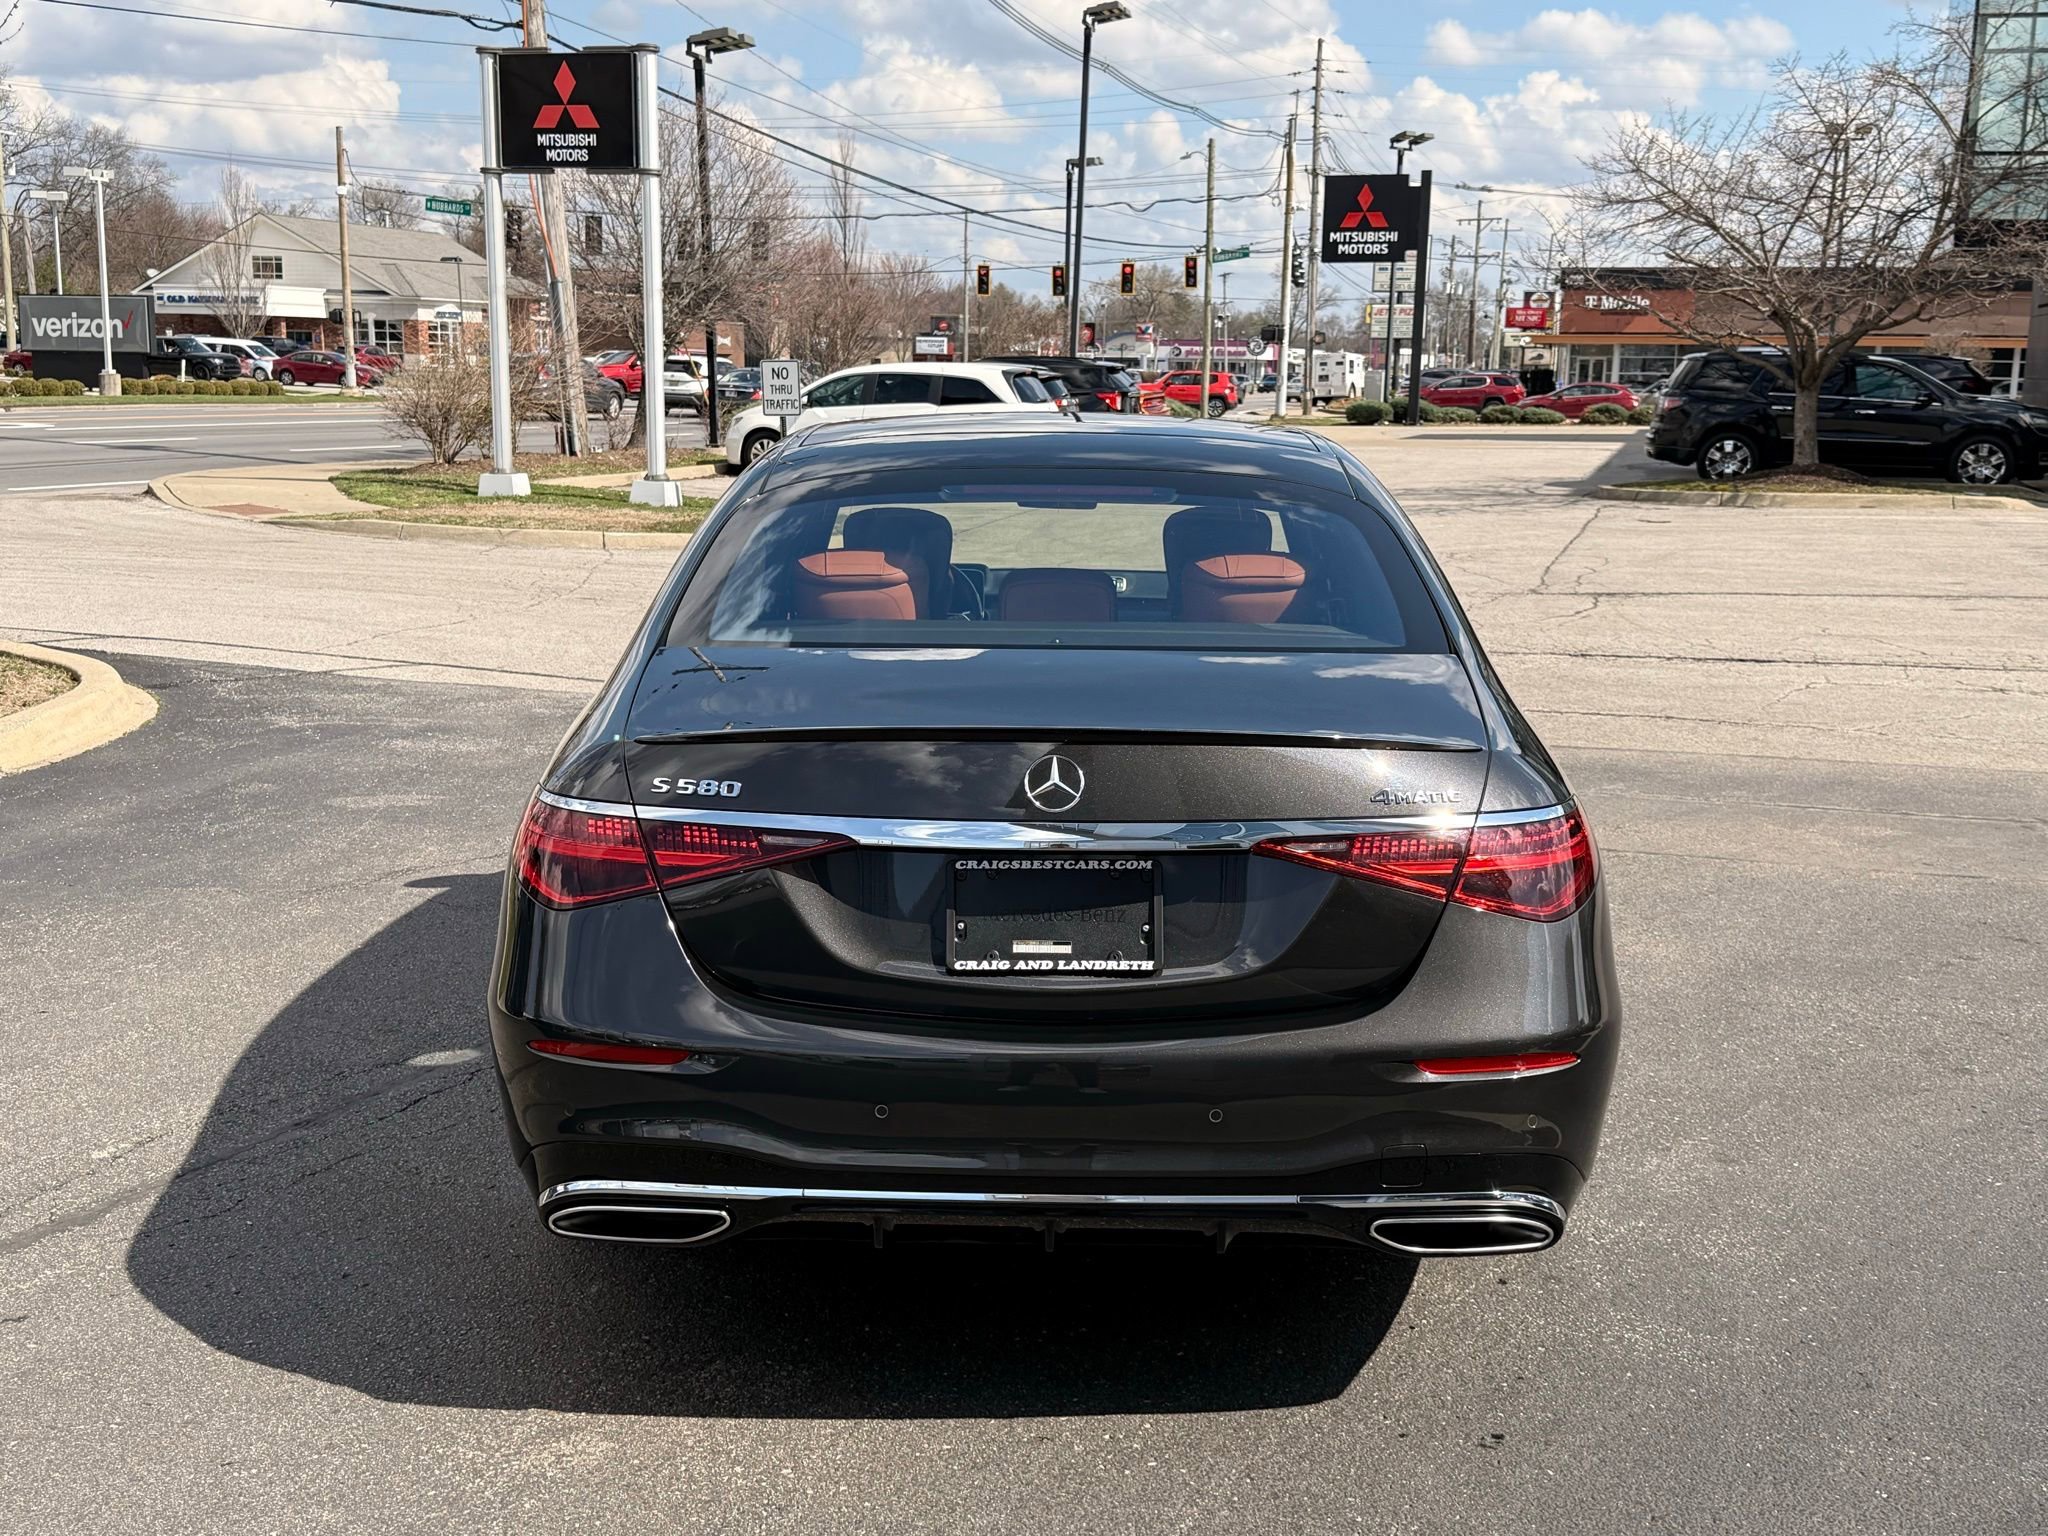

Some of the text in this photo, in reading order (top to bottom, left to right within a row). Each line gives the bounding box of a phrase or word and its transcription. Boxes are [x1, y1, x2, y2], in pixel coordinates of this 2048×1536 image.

[537, 134, 597, 146] MITSUBISHI
[546, 149, 589, 161] MOTORS
[1329, 232, 1399, 242] MITSUBISHI
[1337, 243, 1389, 255] MOTORS
[771, 367, 789, 380] NO
[769, 384, 793, 395] THRU
[765, 398, 799, 410] TRAFFIC
[651, 777, 742, 797] S 580
[1369, 787, 1461, 805] 4MATIC
[955, 859, 1153, 870] CRAIGSBESTCARS.COM
[954, 959, 1155, 971] CRAIG AND LANDRETH
